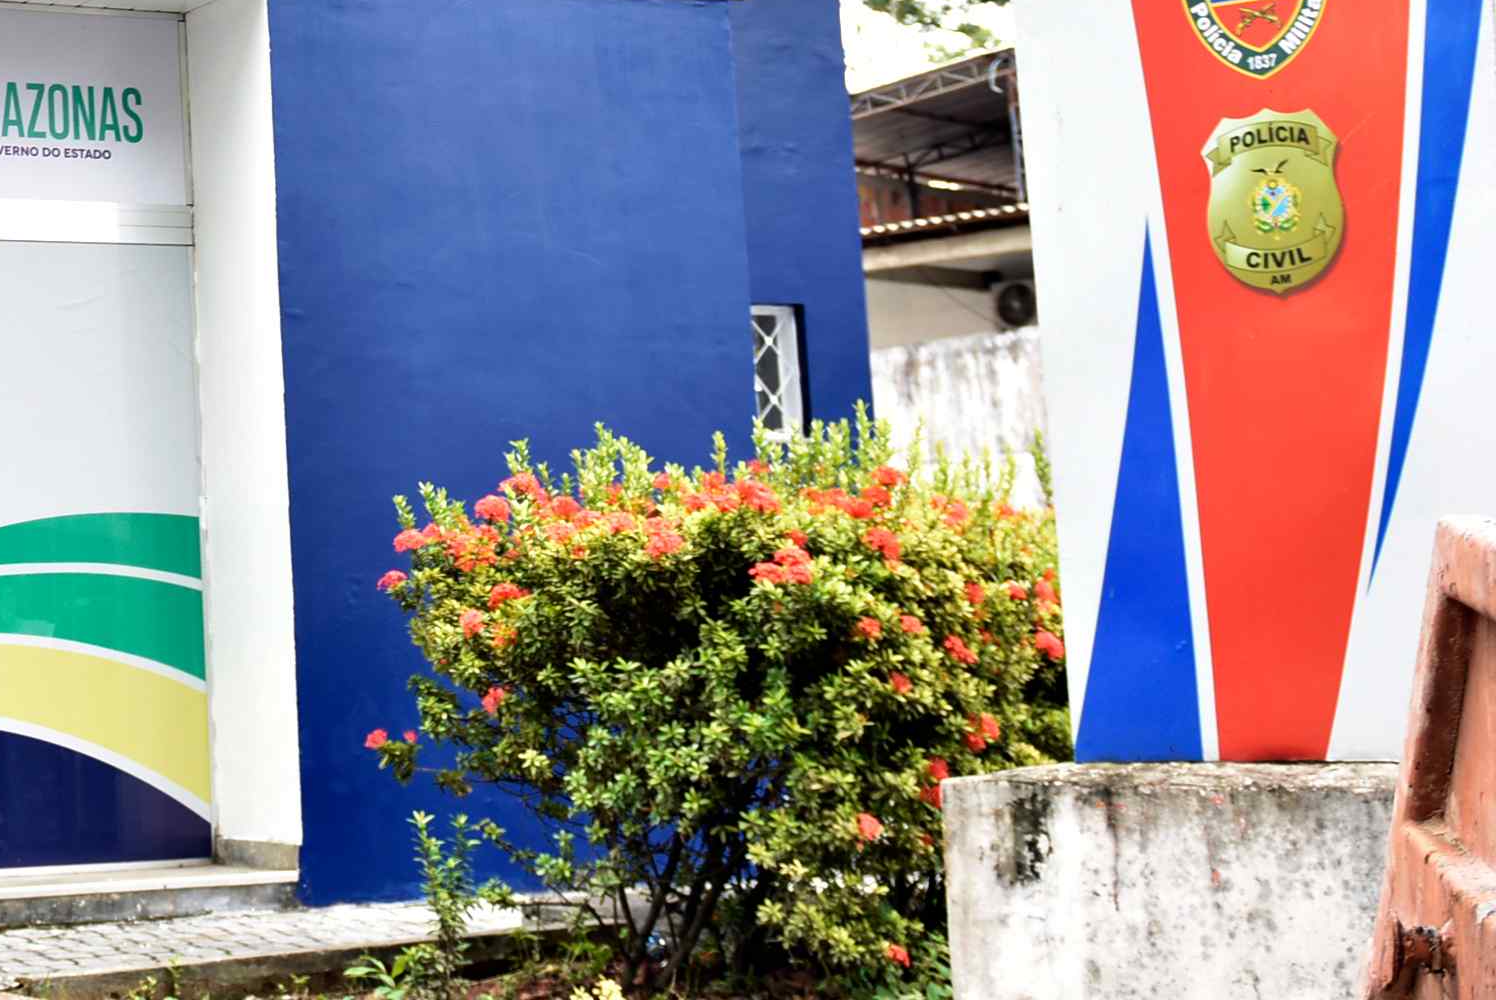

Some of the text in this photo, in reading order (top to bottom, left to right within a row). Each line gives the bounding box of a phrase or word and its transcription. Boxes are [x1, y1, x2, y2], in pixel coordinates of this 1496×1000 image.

[1191, 1, 1243, 64] Polícia
[1247, 53, 1277, 71] 1837
[1229, 122, 1310, 153] POLÍCIA
[42, 147, 61, 158] DO
[63, 148, 112, 160] ESTADO
[1246, 247, 1312, 269] CIVIL
[1271, 274, 1292, 285] AM
